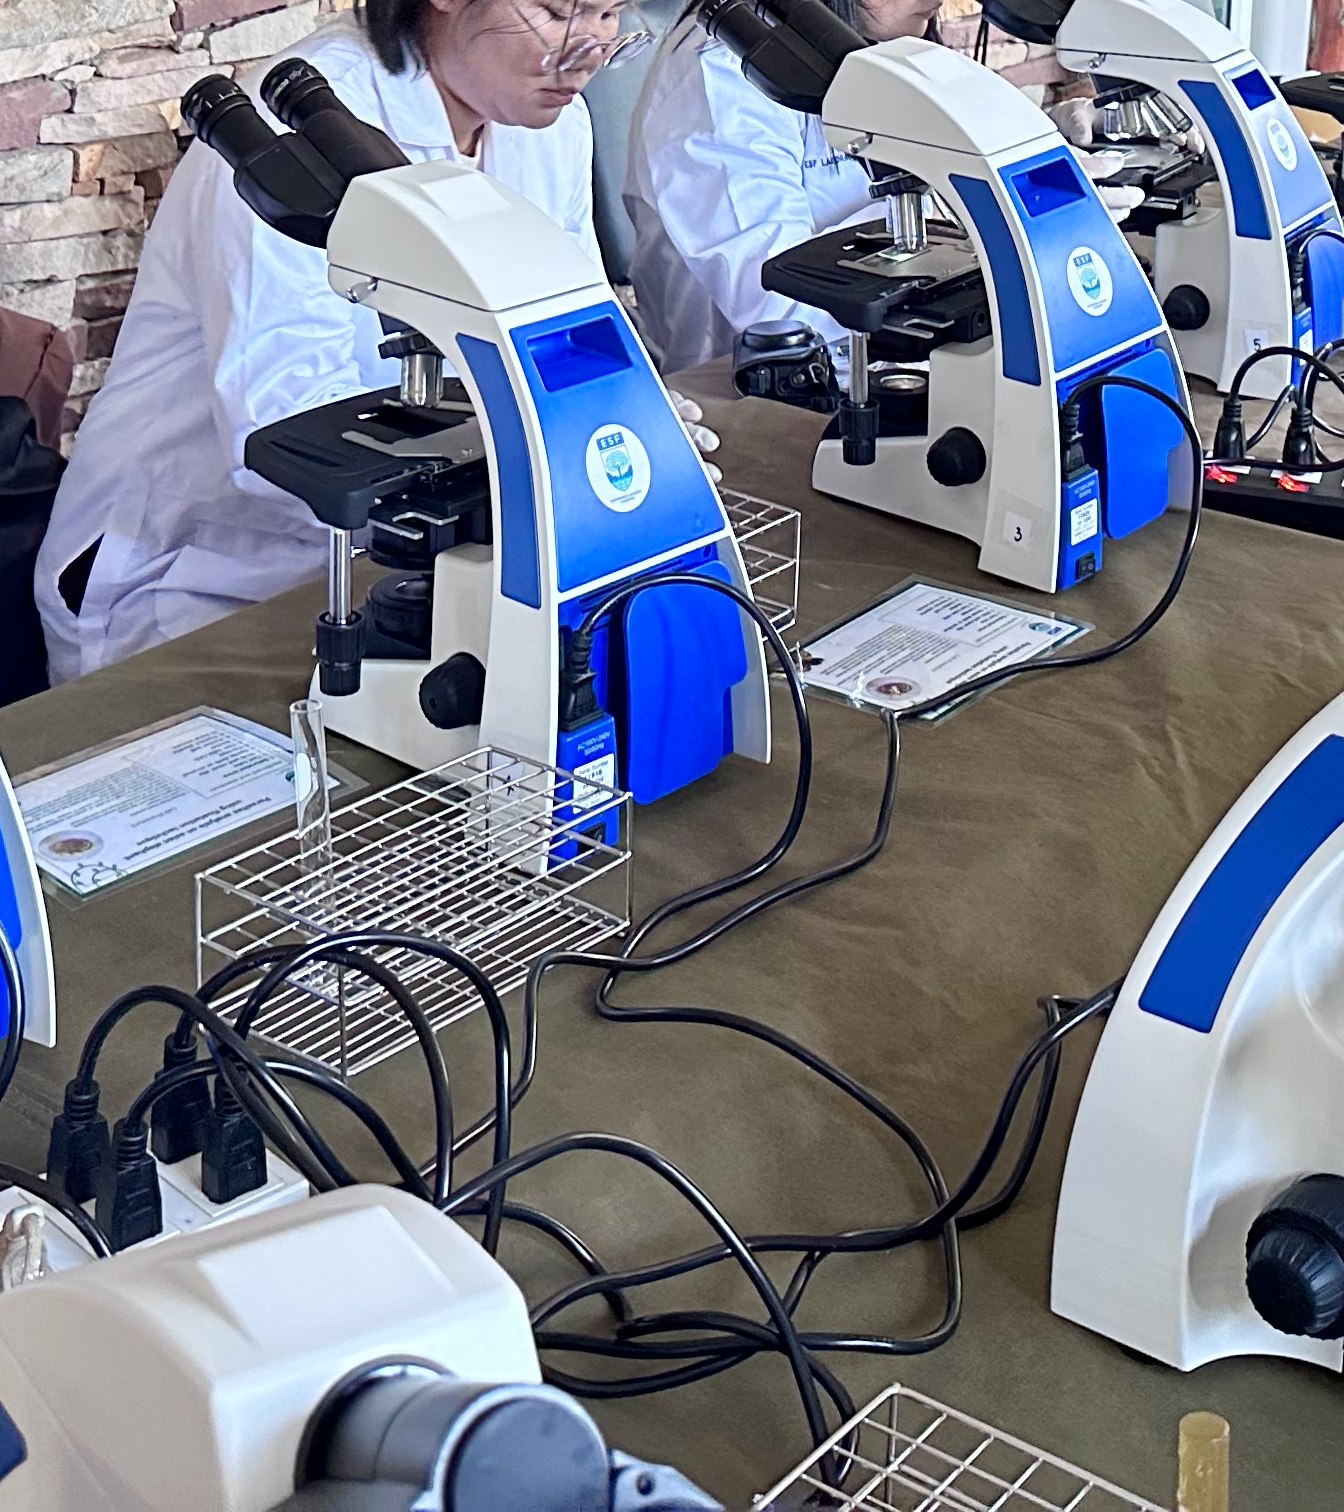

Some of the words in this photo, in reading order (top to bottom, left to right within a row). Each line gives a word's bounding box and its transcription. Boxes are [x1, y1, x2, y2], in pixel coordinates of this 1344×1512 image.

[1253, 338, 1261, 352] 5
[599, 434, 623, 449] ESF
[1014, 526, 1022, 541] 3
